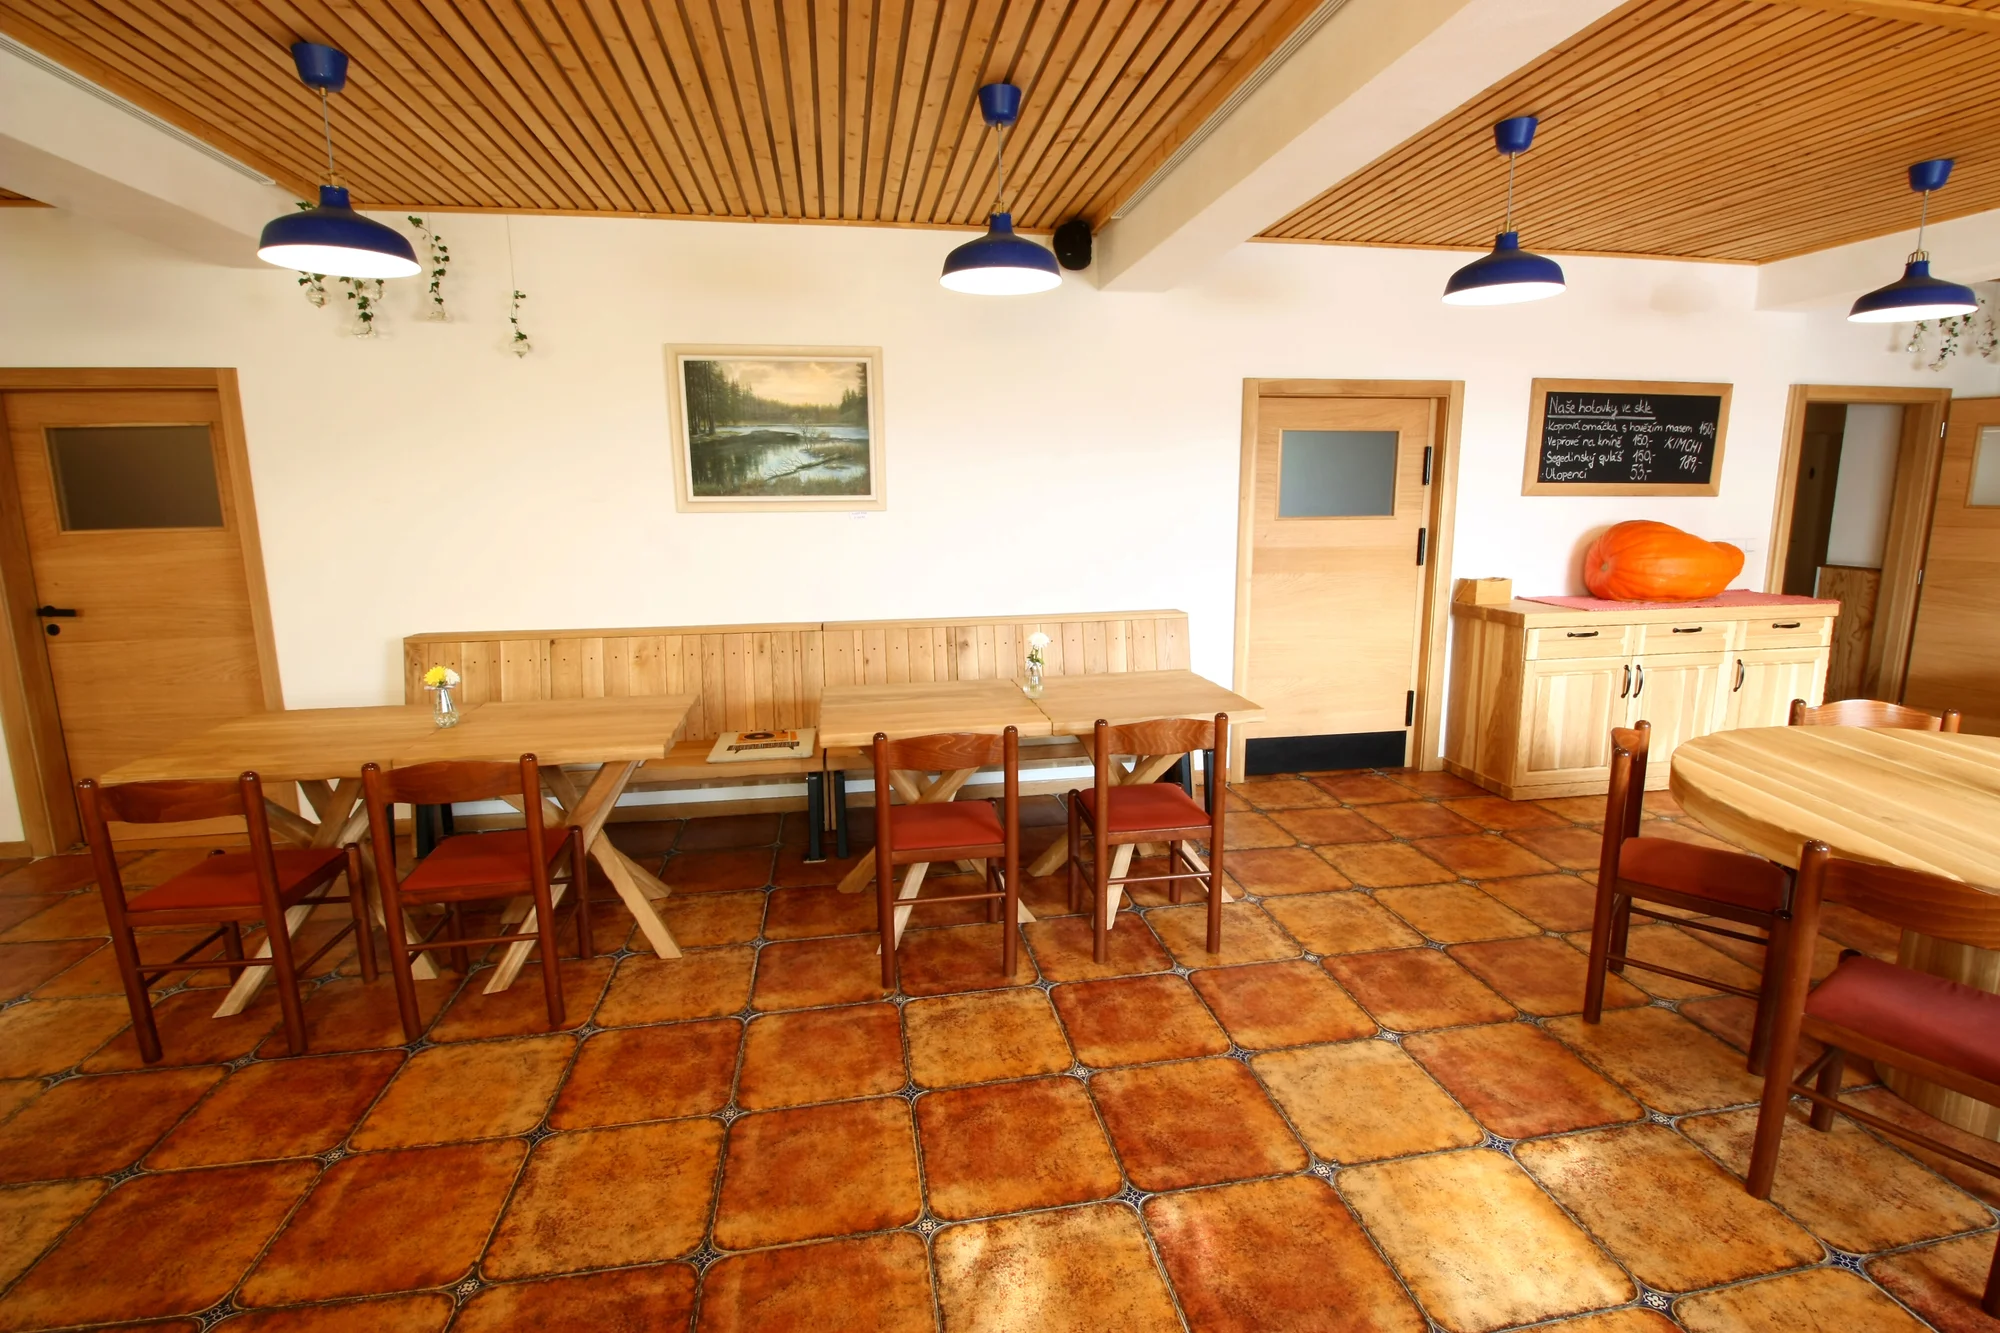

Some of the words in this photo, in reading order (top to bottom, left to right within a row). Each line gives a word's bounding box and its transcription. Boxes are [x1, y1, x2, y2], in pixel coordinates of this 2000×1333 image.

[1549, 396, 1576, 414] Naše
[1578, 398, 1618, 420] hotovky
[1622, 404, 1631, 413] ve
[1634, 399, 1653, 414] skle
[1548, 420, 1581, 433] Koprová
[1582, 421, 1617, 432] omáčka
[1621, 424, 1627, 433] s
[1629, 421, 1663, 433] hovězím
[1665, 424, 1692, 433] masem
[1547, 435, 1582, 450] Vepřové
[1582, 438, 1596, 447] na
[1597, 434, 1623, 448] kmíně
[1632, 434, 1653, 448] 150,-
[1664, 436, 1703, 453] KIMCHI
[1599, 450, 1624, 466] guláš
[1632, 450, 1656, 464] 150,-
[1679, 455, 1703, 473] 189,-
[1630, 464, 1652, 481] 53,-
